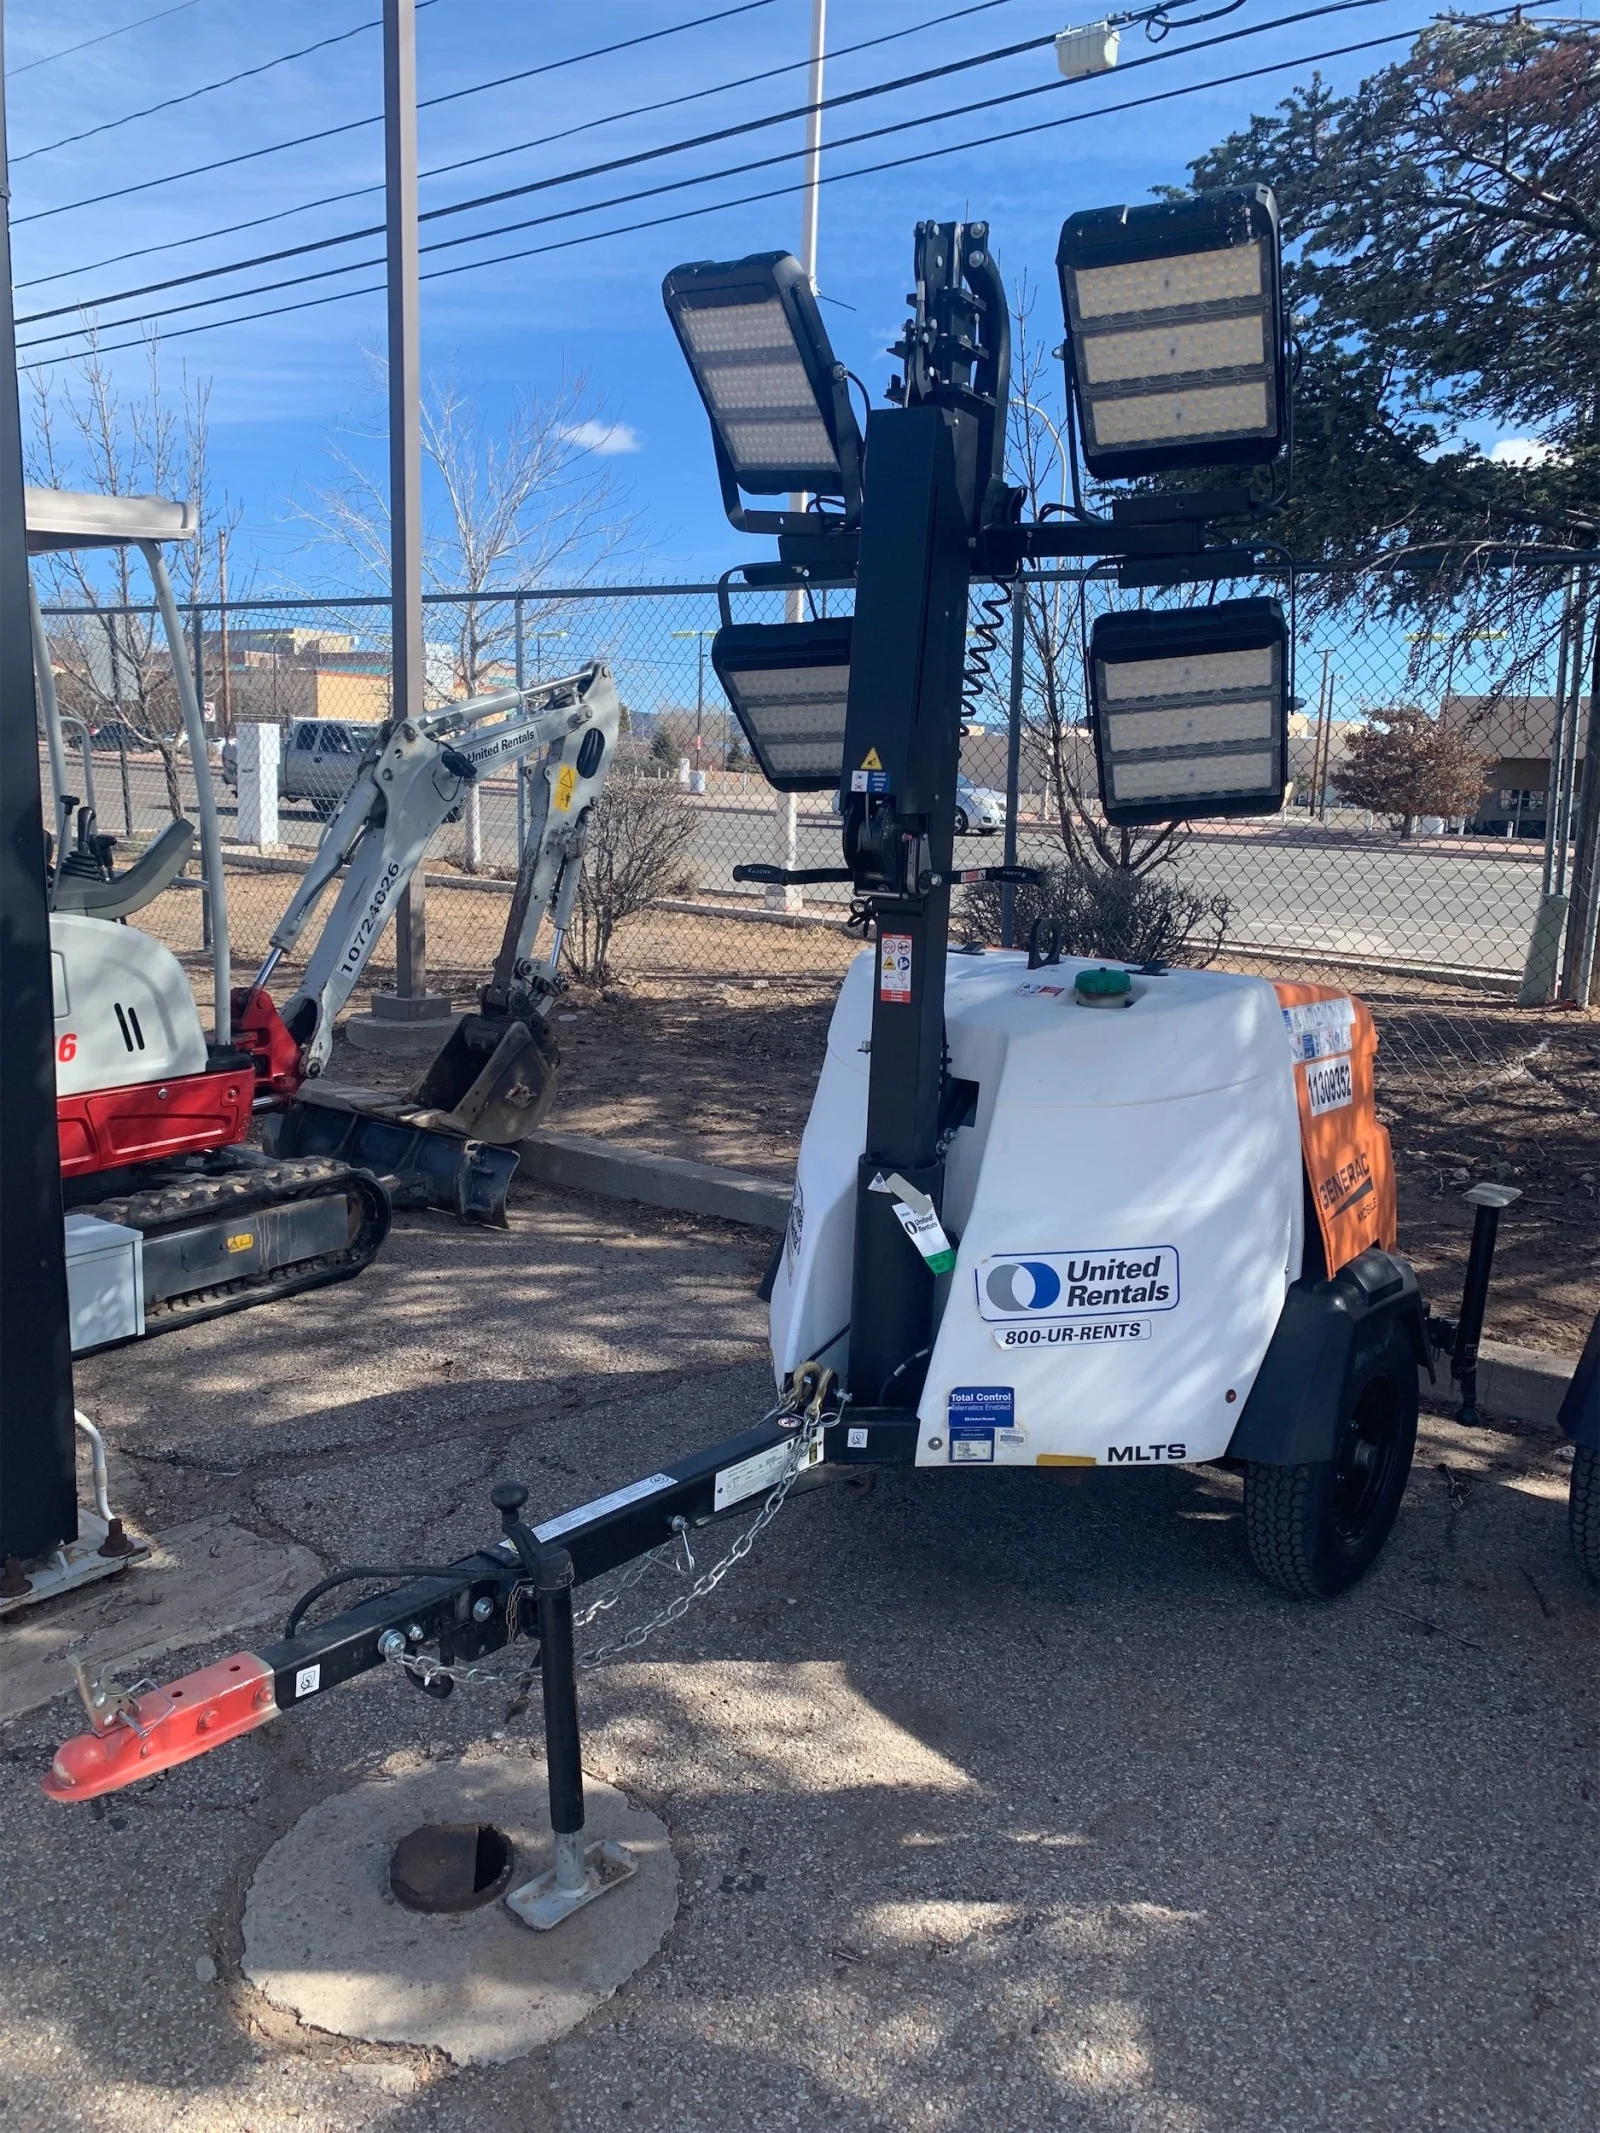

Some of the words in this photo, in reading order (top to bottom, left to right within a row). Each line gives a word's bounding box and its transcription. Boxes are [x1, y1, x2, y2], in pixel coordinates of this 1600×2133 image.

[467, 742, 500, 764] United
[501, 729, 535, 751] Rentals
[341, 862, 399, 974] 10724026
[1308, 1064, 1351, 1106] 11309352
[1319, 1152, 1370, 1210] GENERAC
[914, 1214, 933, 1225] United
[918, 1222, 938, 1232] Rentals
[1067, 1256, 1161, 1283] United
[1067, 1281, 1169, 1307] Rentals
[1005, 1322, 1141, 1345] 800-UR-RENTS
[951, 1393, 974, 1402] Total
[976, 1392, 1011, 1402] Control
[1108, 1443, 1186, 1462] MLTS
